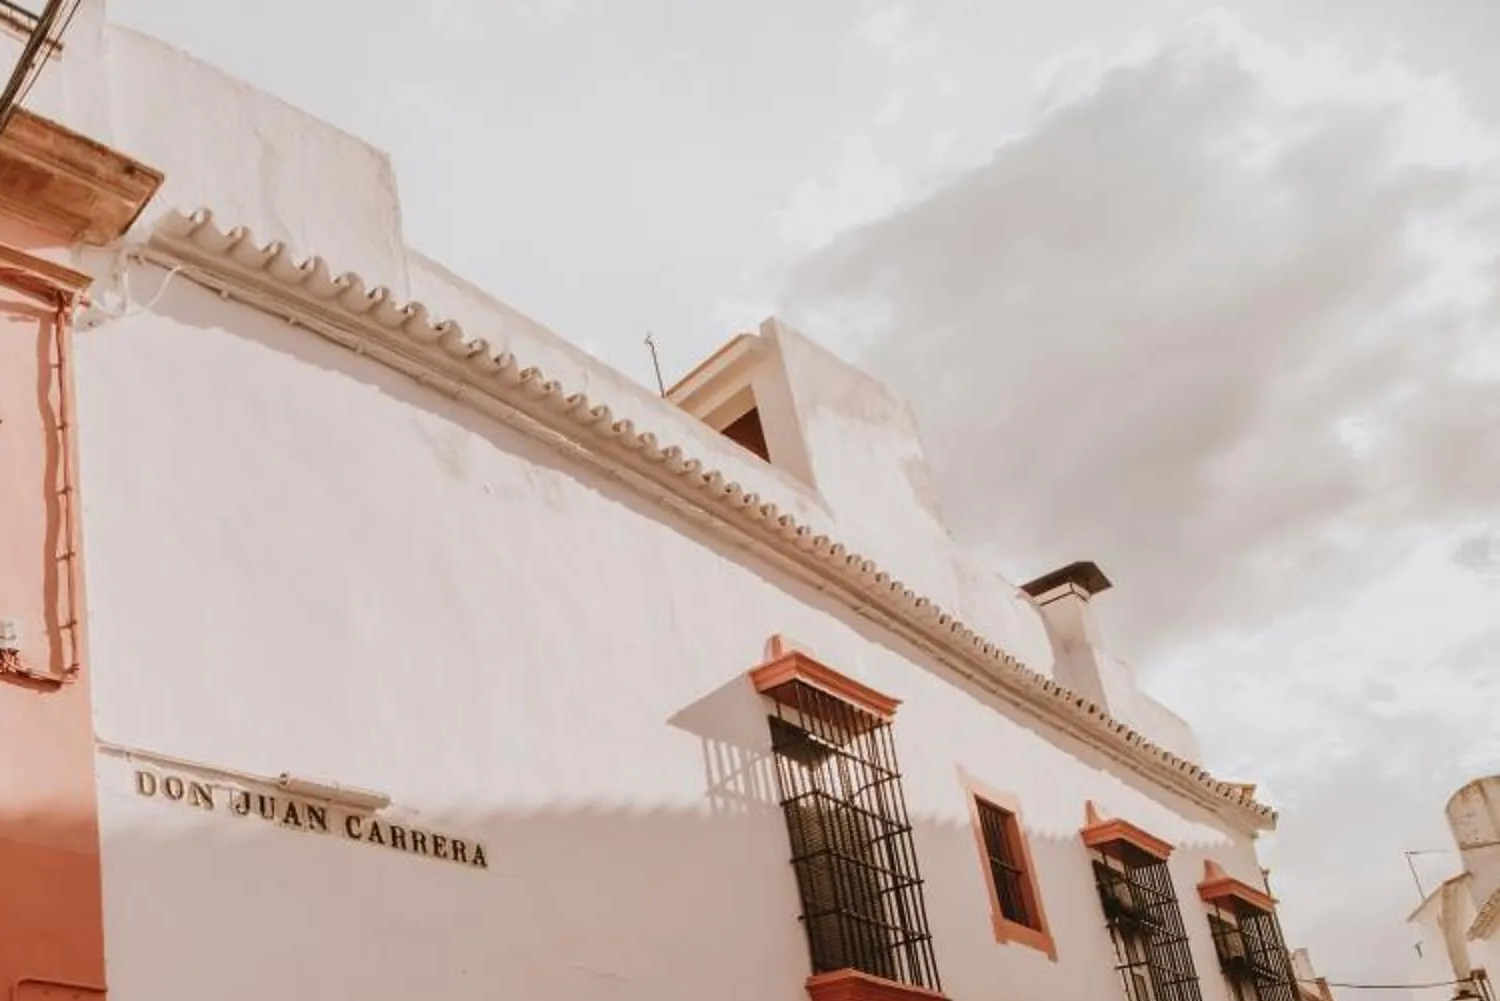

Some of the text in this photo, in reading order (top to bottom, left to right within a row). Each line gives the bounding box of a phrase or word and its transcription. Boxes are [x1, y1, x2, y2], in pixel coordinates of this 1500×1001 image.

[135, 770, 488, 868] DON JUAN CARRERA
